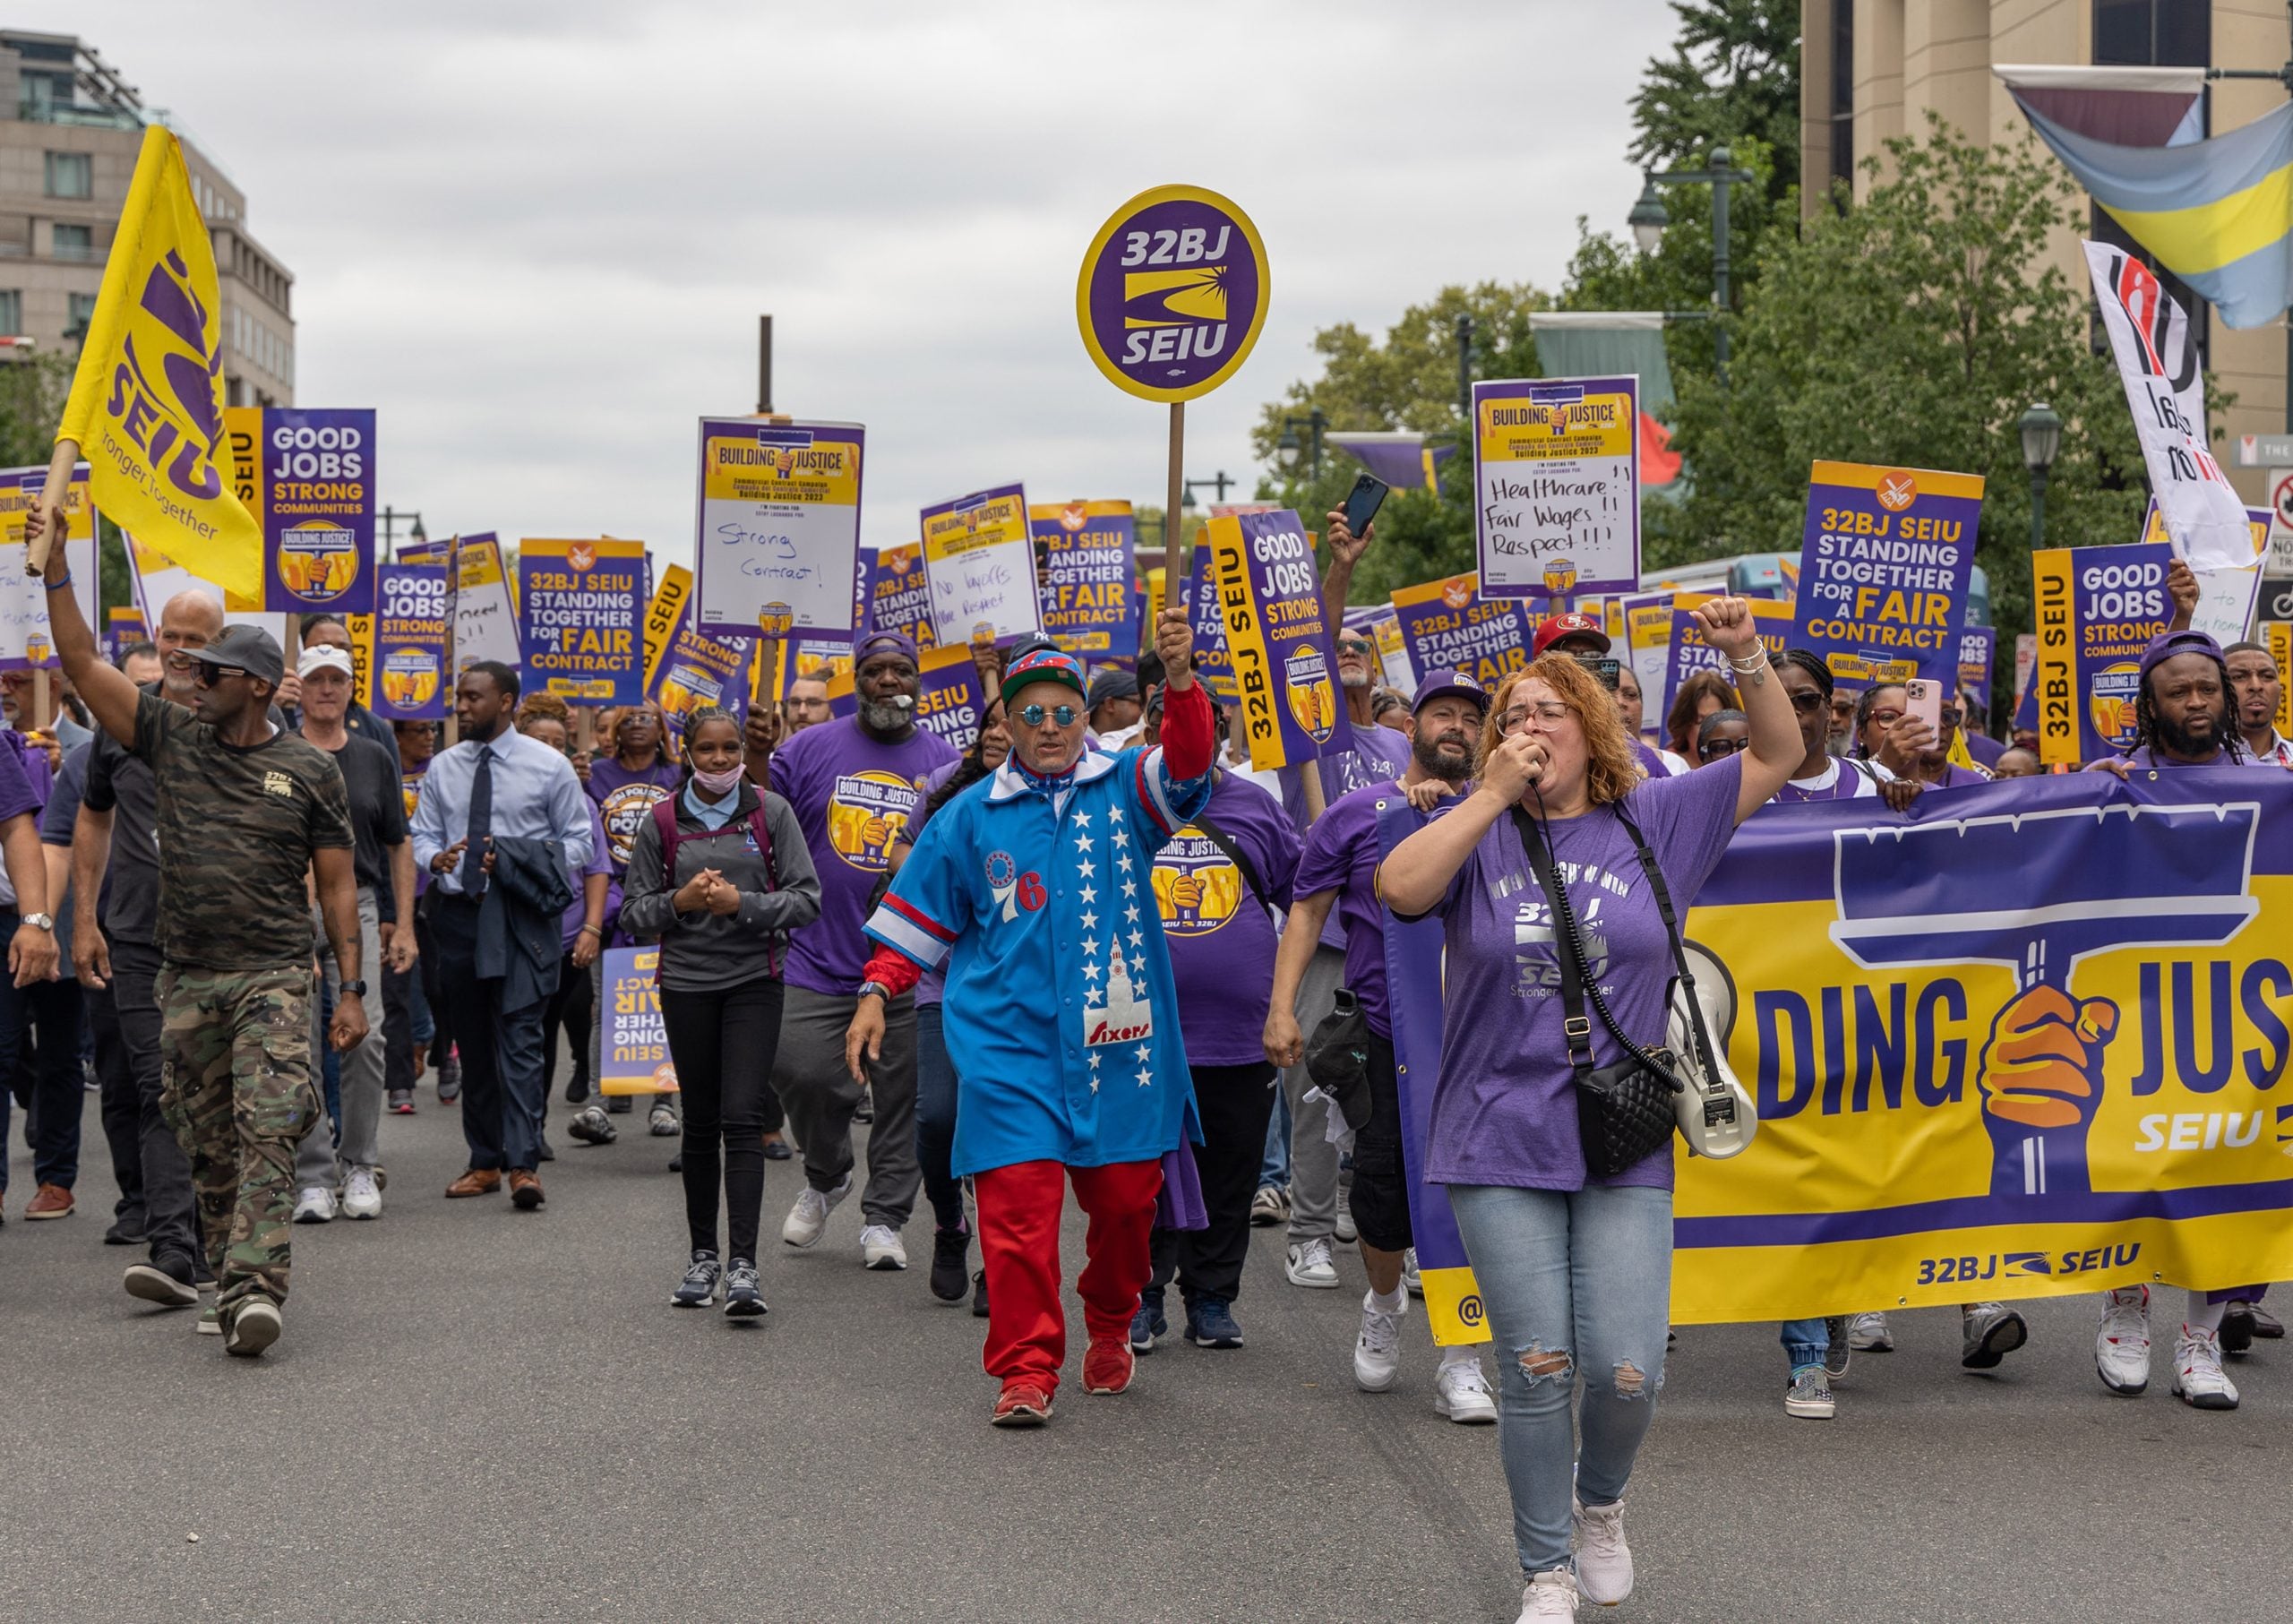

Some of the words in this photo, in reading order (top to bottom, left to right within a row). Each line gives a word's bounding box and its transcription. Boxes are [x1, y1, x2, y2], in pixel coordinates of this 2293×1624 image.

[1121, 225, 1232, 267] 32BJ
[1121, 323, 1228, 365] SEIU
[1492, 408, 1548, 426] BUILDING
[1569, 404, 1614, 423] JUSTICE
[107, 363, 221, 500] SEIU
[273, 427, 361, 450] GOOD
[719, 447, 775, 467] BUILDING
[795, 451, 842, 469] JUSTICE
[1516, 449, 1547, 458] Building
[1550, 448, 1577, 456] Justice
[1580, 447, 1599, 455] 2023
[273, 452, 363, 479] JOBS
[101, 426, 147, 482] ronger
[148, 475, 218, 542] Together
[274, 483, 364, 501] STRONG
[740, 490, 770, 499] Building
[774, 492, 802, 500] Justice
[273, 503, 364, 514] COMMUNITIES
[932, 515, 966, 535] BUILDING
[978, 504, 1010, 521] JUSTICE
[1484, 504, 1524, 529] Fair
[1821, 508, 1890, 537] 32BJ
[1899, 518, 1962, 543] SEIU
[286, 533, 321, 544] BUILDING
[322, 533, 351, 544] JUSTICE
[717, 523, 797, 559] Strong
[1079, 532, 1122, 548] SEIU
[1253, 531, 1304, 563] GOOD
[1817, 535, 1959, 567] STANDING
[1048, 549, 1124, 567] ANDING
[382, 578, 446, 596] GOOD
[529, 572, 579, 590] 32BJ
[587, 574, 632, 590] SEIU
[1046, 565, 1124, 584] GETHER
[1261, 561, 1313, 598] JOBS
[1816, 558, 1955, 591] TOGETHER
[2083, 563, 2162, 590] GOOD
[874, 577, 905, 598] 2BJ
[1040, 587, 1056, 598] OR
[1059, 583, 1125, 609] FAIR
[1219, 547, 1250, 632] SEIU
[382, 597, 445, 617] JOBS
[459, 602, 498, 621] need
[529, 591, 633, 610] STANDING
[650, 580, 682, 634] SEIU
[873, 587, 929, 614] STANDI
[1047, 599, 1058, 611] A
[1266, 597, 1318, 624] STRONG
[1812, 580, 1853, 601] FOR
[1854, 587, 1951, 627] FAIR
[1835, 603, 1851, 619] A
[2042, 575, 2066, 647] SEIU
[2083, 590, 2164, 621] JOBS
[382, 621, 444, 634] STRONG
[529, 609, 632, 627] TOGETHER
[876, 604, 932, 629] TOGETH
[1044, 609, 1126, 626] ONTRACT
[1412, 609, 1461, 636] 32BJ
[1467, 600, 1512, 627] SEIU
[381, 635, 444, 644] COMMUNITIES
[531, 626, 560, 640] FOR
[563, 629, 632, 653] FAIR
[1215, 637, 1225, 649] A
[1271, 621, 1322, 641] COMMUNITIES
[1416, 614, 1517, 653] STANDING
[1808, 618, 1948, 649] CONTRACT
[2084, 621, 2168, 643] STRONG
[550, 640, 561, 653] A
[679, 631, 742, 666] STRONG
[1419, 629, 1522, 669] TOGETHER
[530, 654, 633, 671] CONTRACT
[674, 644, 735, 677] COMMUNITIES
[1288, 657, 1306, 675] BUILDING
[1307, 656, 1325, 672] JUSTICE
[1834, 658, 1868, 673] BUILDING
[1881, 665, 1909, 677] JUSTICE
[2095, 675, 2127, 688] BUILDING
[916, 683, 969, 715] SEIU
[1238, 649, 1272, 741] 32BJ
[2047, 661, 2070, 737] 32BJ
[915, 706, 975, 734] DING
[839, 780, 883, 800] BUILDING
[1601, 871, 1628, 898] WIN
[992, 871, 1047, 924] 76
[1510, 985, 1559, 999] Stronger
[614, 1029, 667, 1044] DING
[1088, 1021, 1149, 1044] Sixers
[614, 1045, 664, 1061] SEIU
[1753, 977, 1968, 1121] DING
[2134, 1110, 2263, 1153] SEIU
[1918, 1253, 1997, 1285] 32BJ
[2059, 1242, 2142, 1274] SEIU
[1458, 1294, 1483, 1327] @
